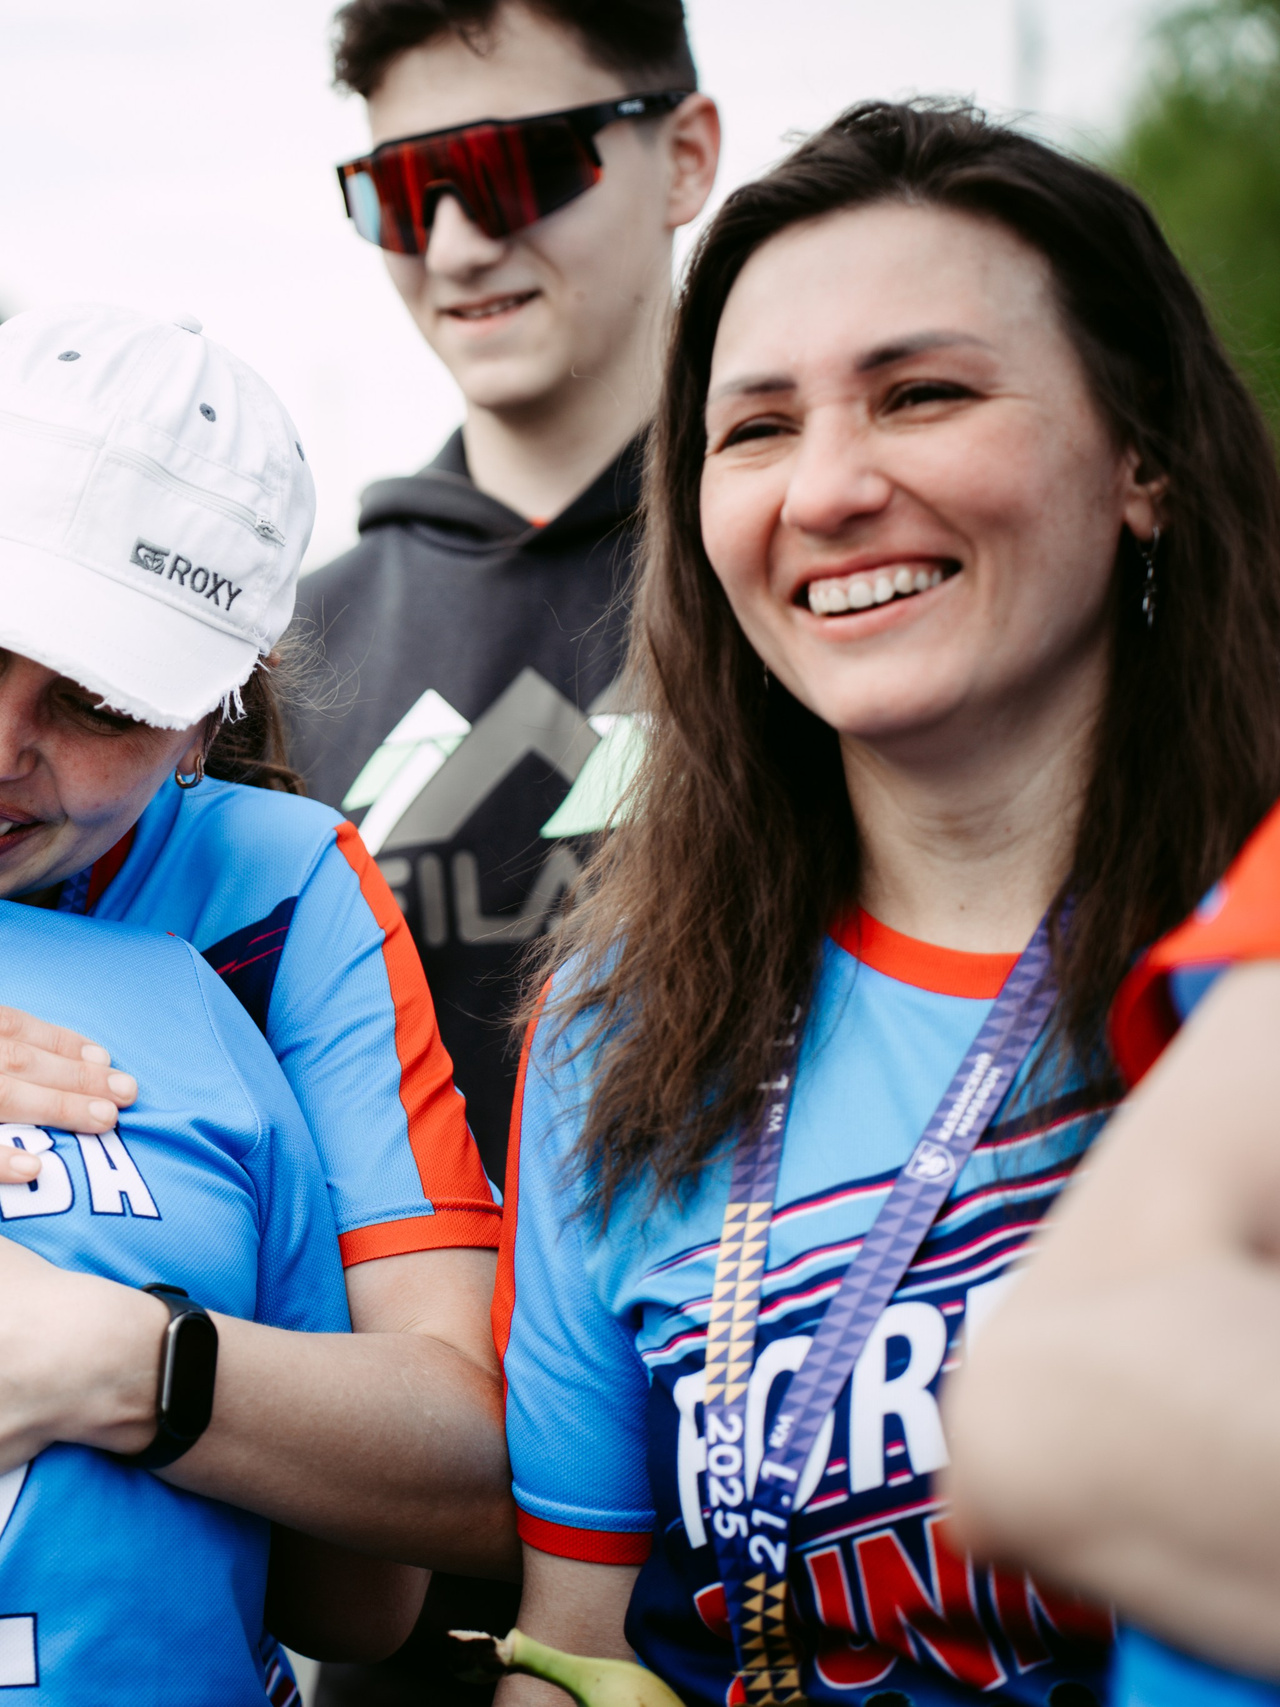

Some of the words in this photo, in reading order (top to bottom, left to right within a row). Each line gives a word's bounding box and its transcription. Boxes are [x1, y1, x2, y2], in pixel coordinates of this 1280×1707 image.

[168, 552, 242, 612] ROXY
[706, 1412, 750, 1539] 2025
[748, 1459, 799, 1574] 21.1
